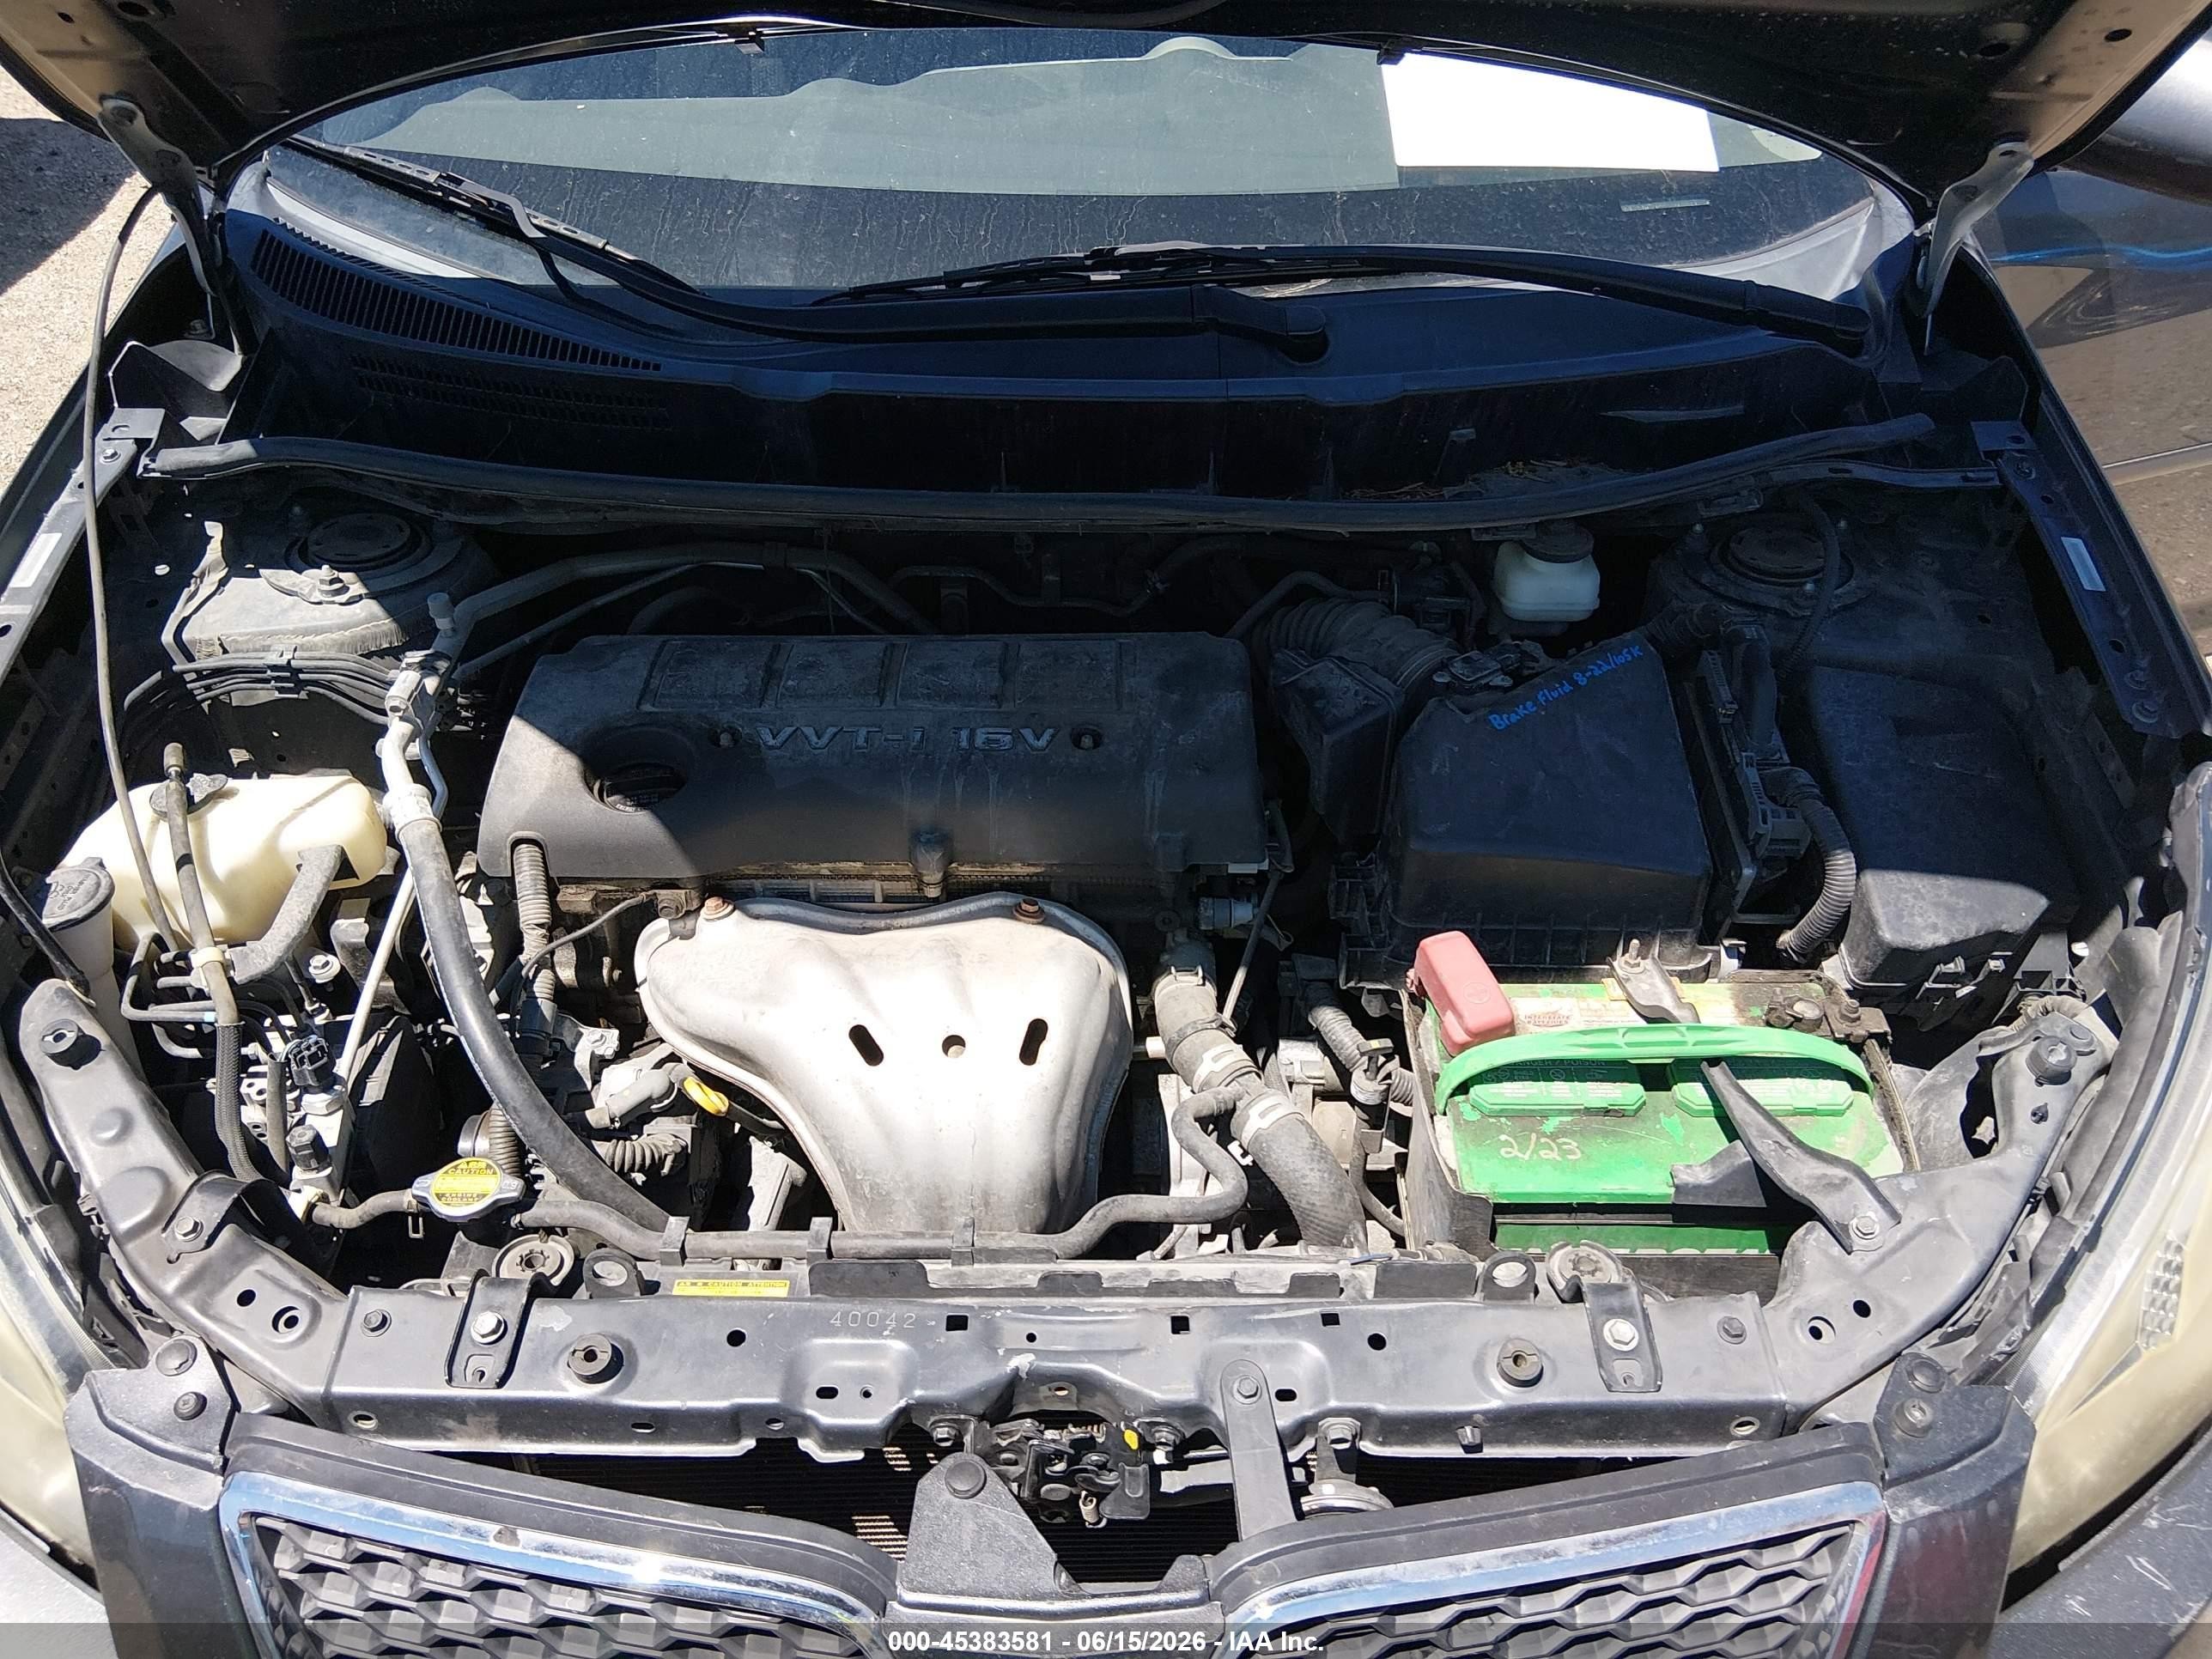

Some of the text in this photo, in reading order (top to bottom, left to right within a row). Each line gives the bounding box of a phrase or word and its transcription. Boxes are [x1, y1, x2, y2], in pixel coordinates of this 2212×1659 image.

[954, 726, 1059, 750] 16V
[1498, 1133, 1582, 1161] 2/23
[830, 1311, 916, 1328] 40042
